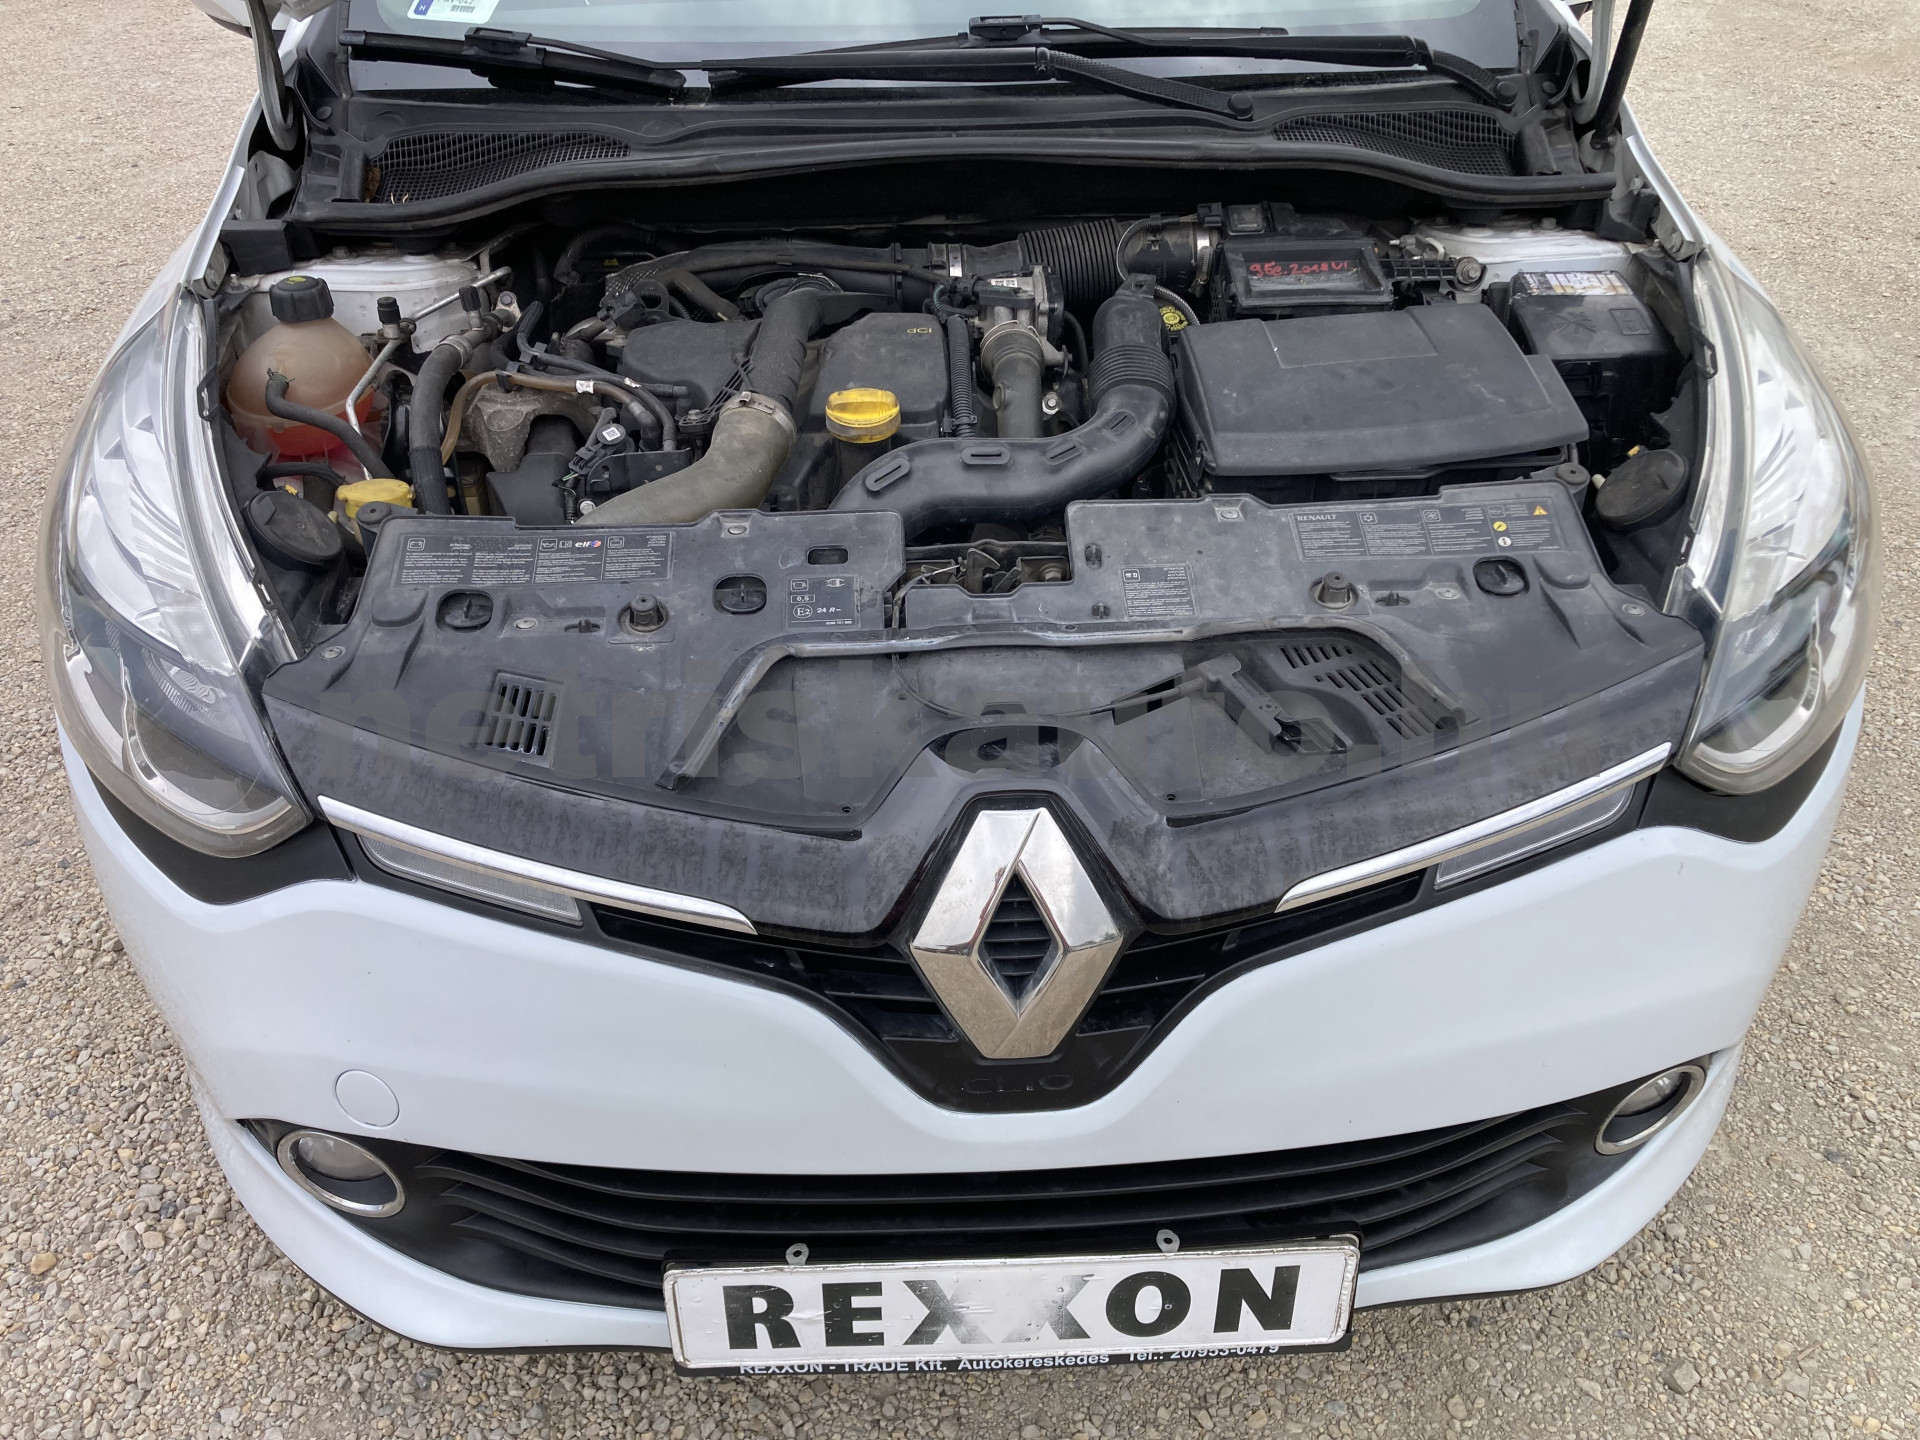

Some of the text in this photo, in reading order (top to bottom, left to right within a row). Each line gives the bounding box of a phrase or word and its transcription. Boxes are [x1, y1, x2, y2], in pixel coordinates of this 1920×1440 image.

[796, 607, 811, 616] E2
[963, 1074, 1074, 1094] CLIO
[722, 1264, 1301, 1349] REXXON
[915, 1360, 947, 1372] Kft.
[958, 1353, 1110, 1371] Autokereskedes
